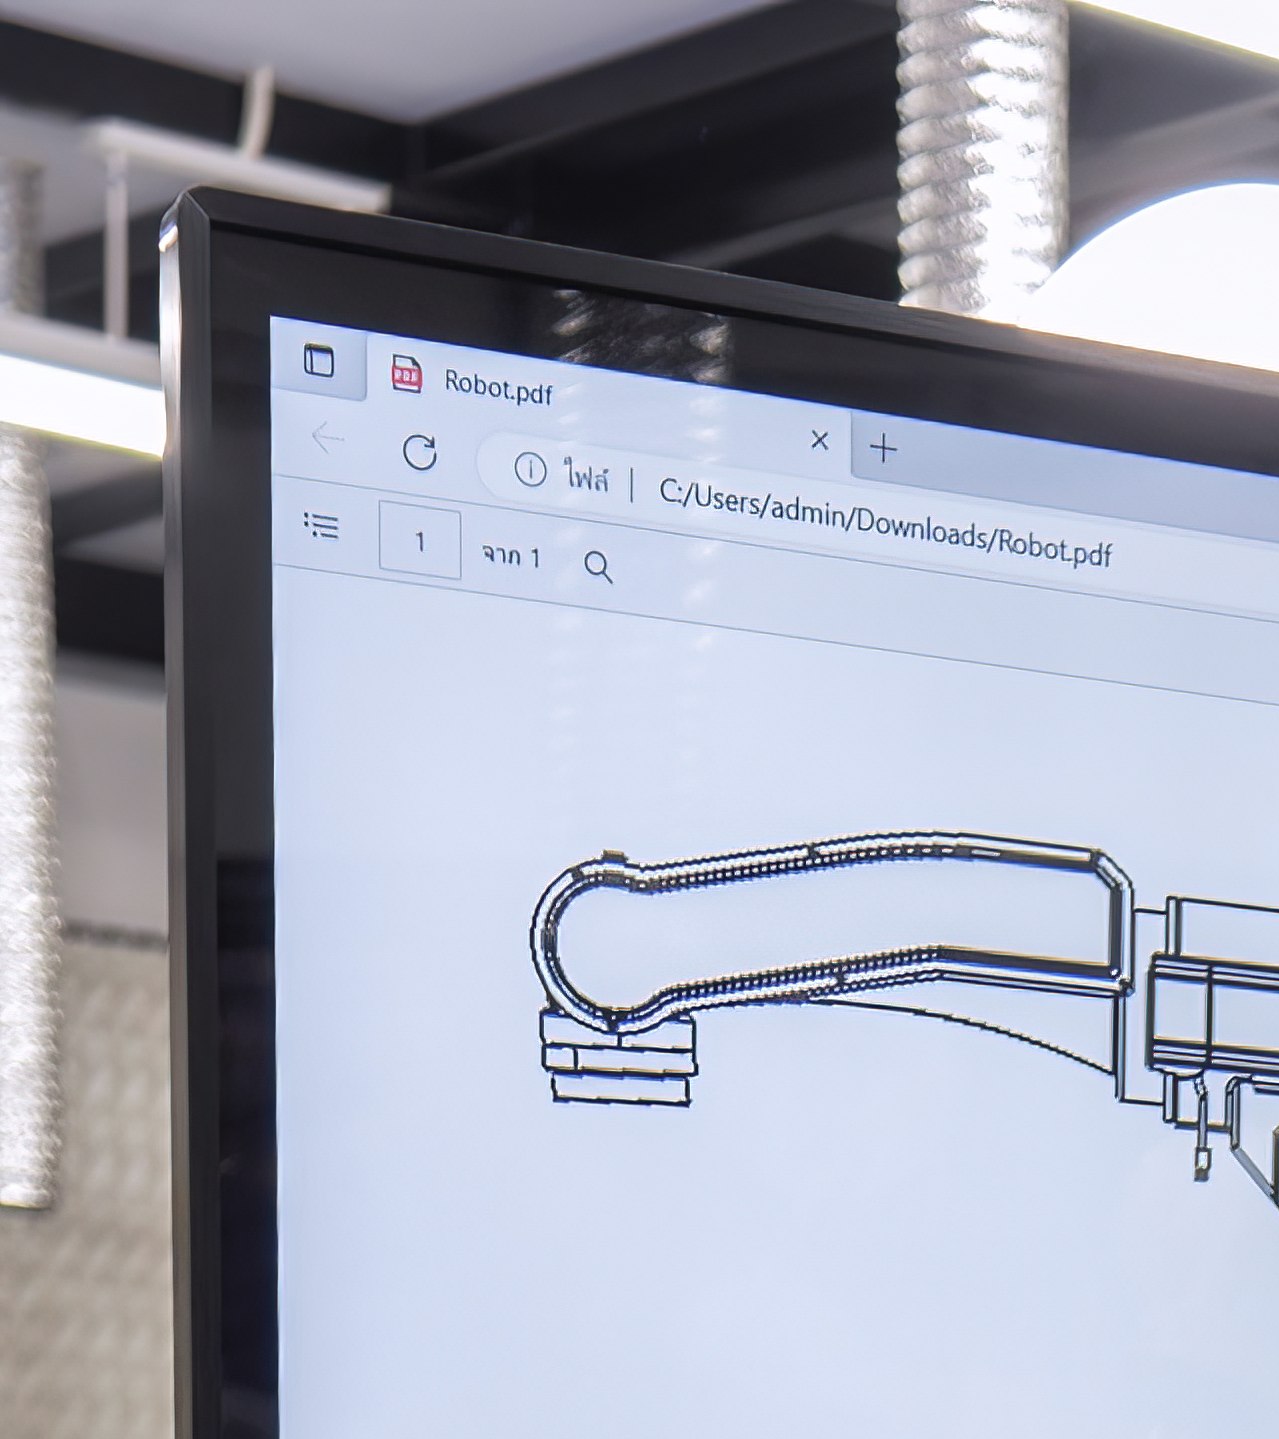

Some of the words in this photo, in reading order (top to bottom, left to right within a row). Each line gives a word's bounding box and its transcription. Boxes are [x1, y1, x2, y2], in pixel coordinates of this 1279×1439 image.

[445, 368, 553, 406] Robot.pdf
[563, 455, 609, 492] ไฟล์
[659, 477, 1113, 568] C:/Users/admin/Downloads/Robot.pdf
[415, 531, 424, 551] 1
[531, 547, 539, 568] 1
